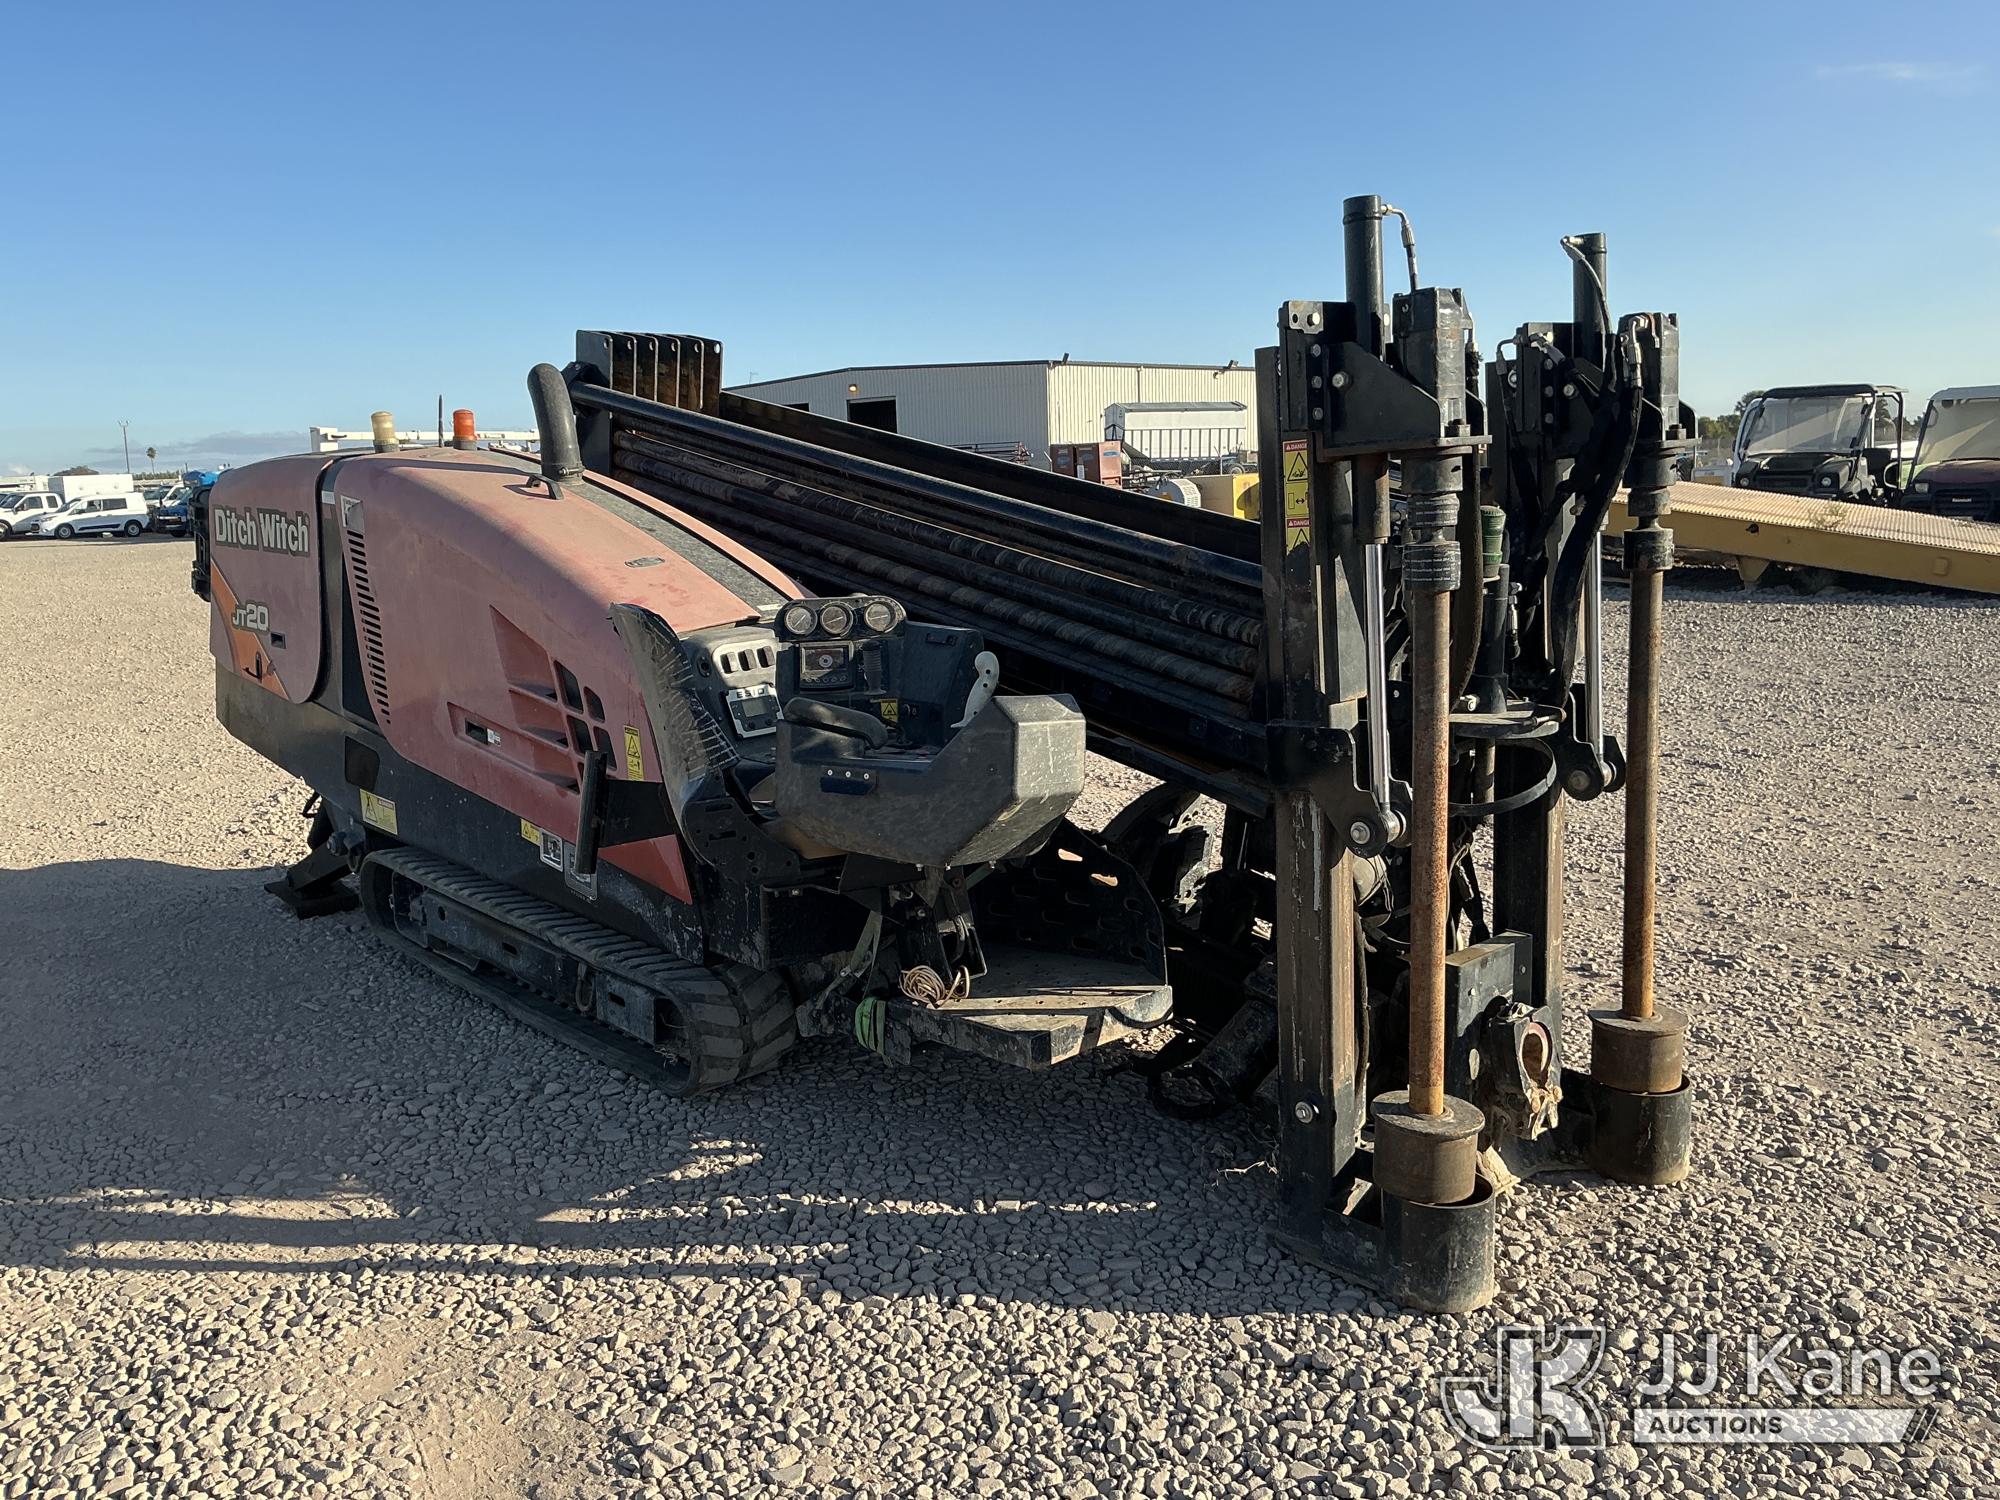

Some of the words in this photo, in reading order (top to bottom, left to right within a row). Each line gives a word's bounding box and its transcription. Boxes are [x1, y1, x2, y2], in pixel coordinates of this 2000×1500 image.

[214, 509, 257, 546] Ditch
[259, 512, 309, 553] Witch
[232, 603, 269, 631] JT20
